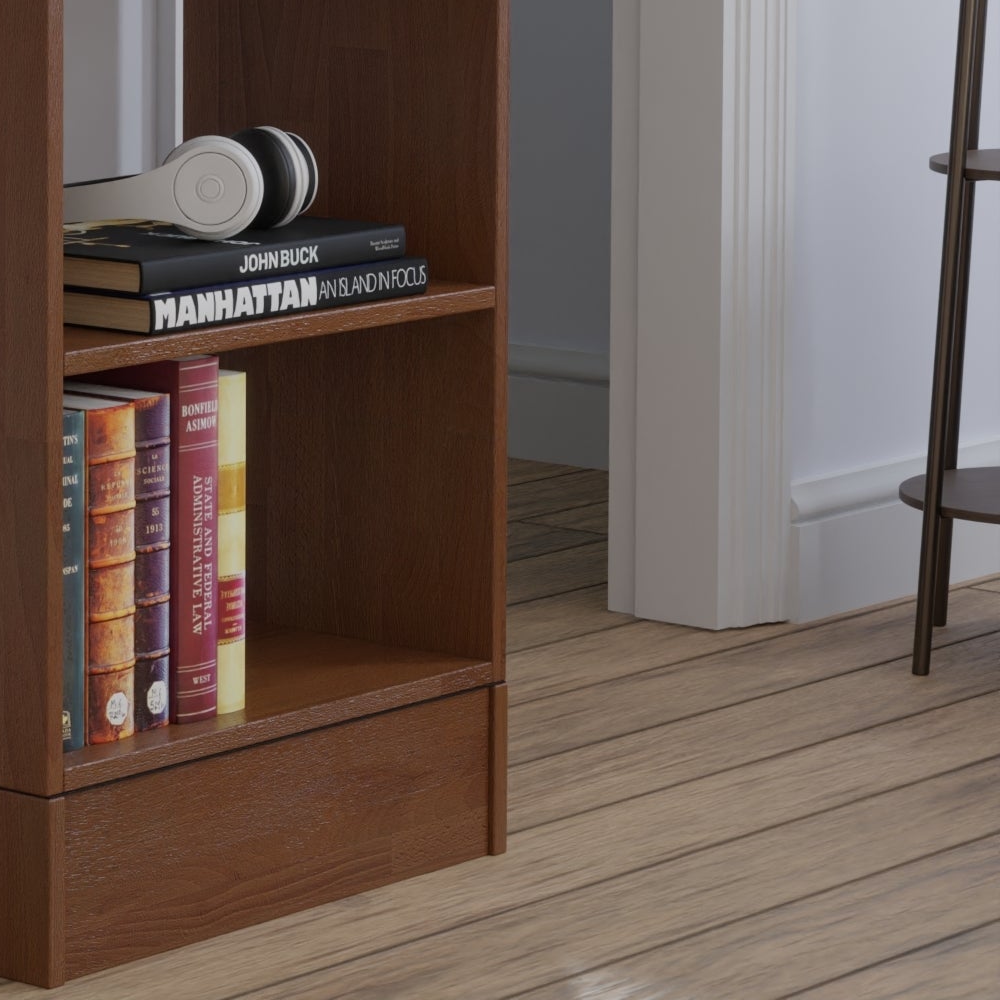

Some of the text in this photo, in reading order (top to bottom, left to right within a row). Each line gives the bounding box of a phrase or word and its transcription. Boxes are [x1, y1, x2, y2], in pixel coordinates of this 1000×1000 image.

[239, 245, 319, 274] JOHN BUCK
[154, 265, 427, 331] MANHATTAN AN ISLAND IN FOCUS
[145, 523, 163, 534] 1913
[192, 475, 203, 636] ADMINISTRATIVE LAW
[203, 476, 213, 631] STATE AND FEDERAL
[192, 674, 211, 685] WEST
